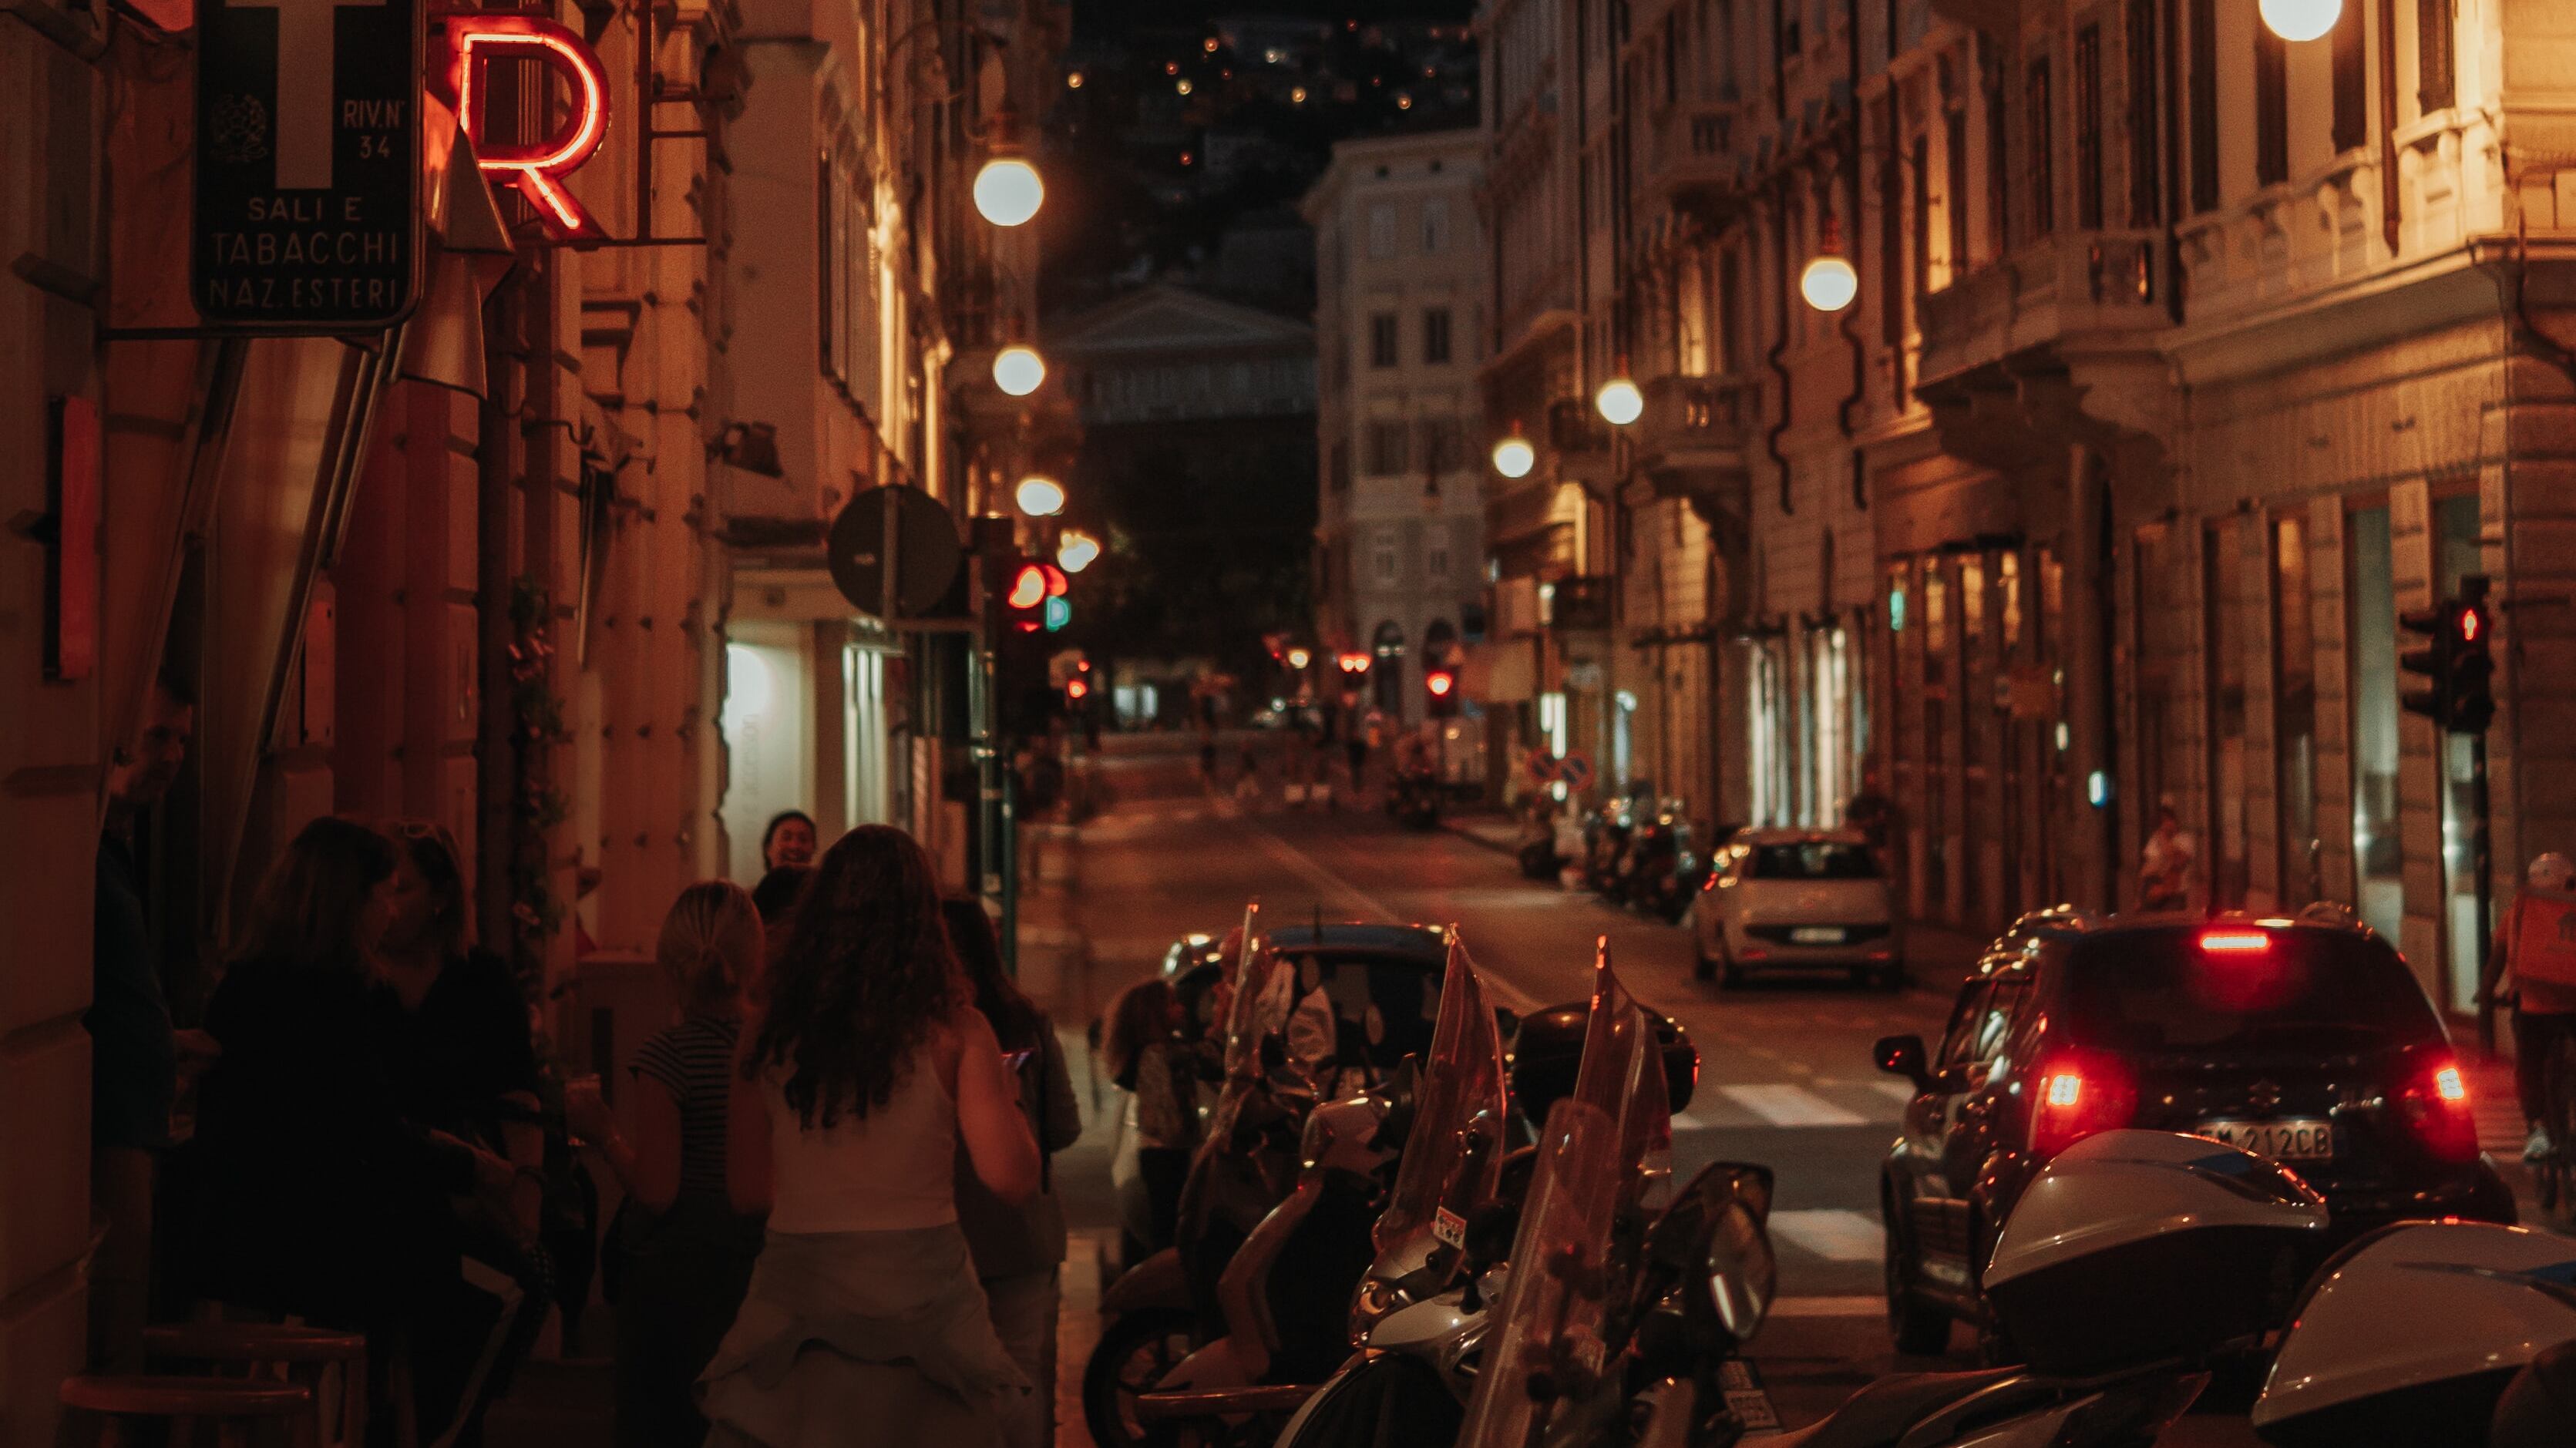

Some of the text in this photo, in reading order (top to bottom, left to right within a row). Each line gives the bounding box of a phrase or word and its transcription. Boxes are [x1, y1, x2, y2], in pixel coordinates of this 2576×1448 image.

[358, 134, 392, 160] 34
[247, 196, 365, 223] SALI E
[210, 231, 399, 266] TABACCHI
